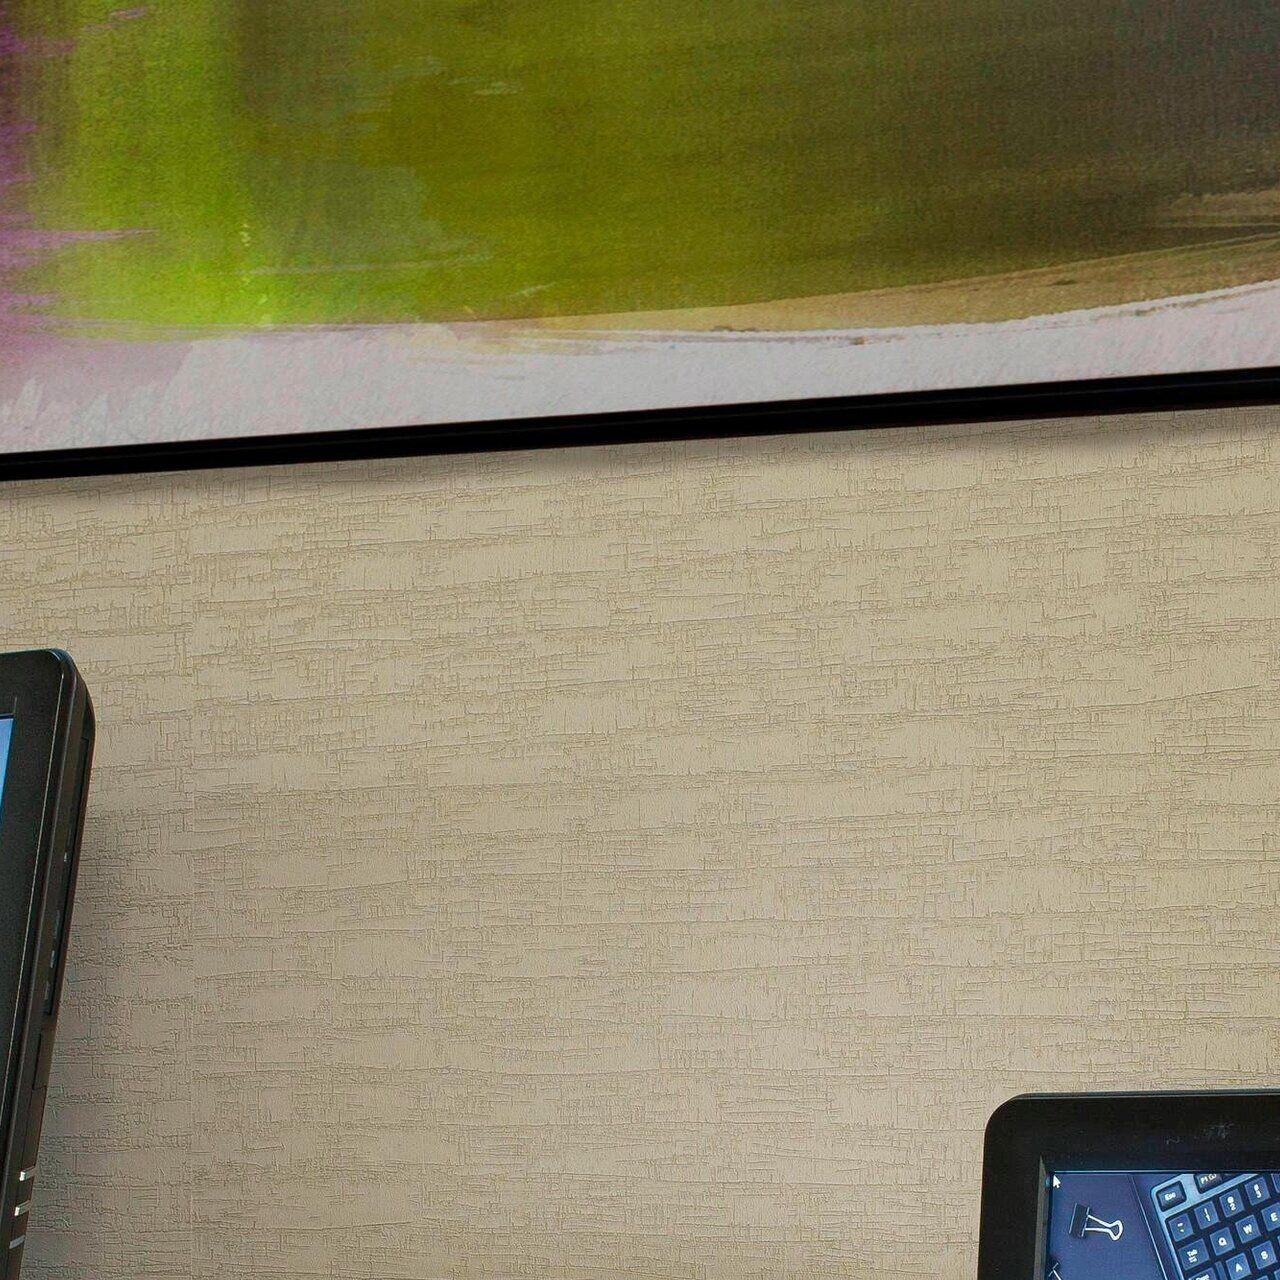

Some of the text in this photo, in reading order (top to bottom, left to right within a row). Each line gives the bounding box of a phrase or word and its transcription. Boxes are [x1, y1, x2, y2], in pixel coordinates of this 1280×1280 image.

[1256, 1190, 1262, 1199] 3
[1229, 1202, 1236, 1211] 2
[1271, 1213, 1278, 1221] E
[1243, 1224, 1252, 1234] W
[1219, 1238, 1227, 1246] Q
[1261, 1251, 1268, 1259] S
[1236, 1263, 1242, 1272] A
